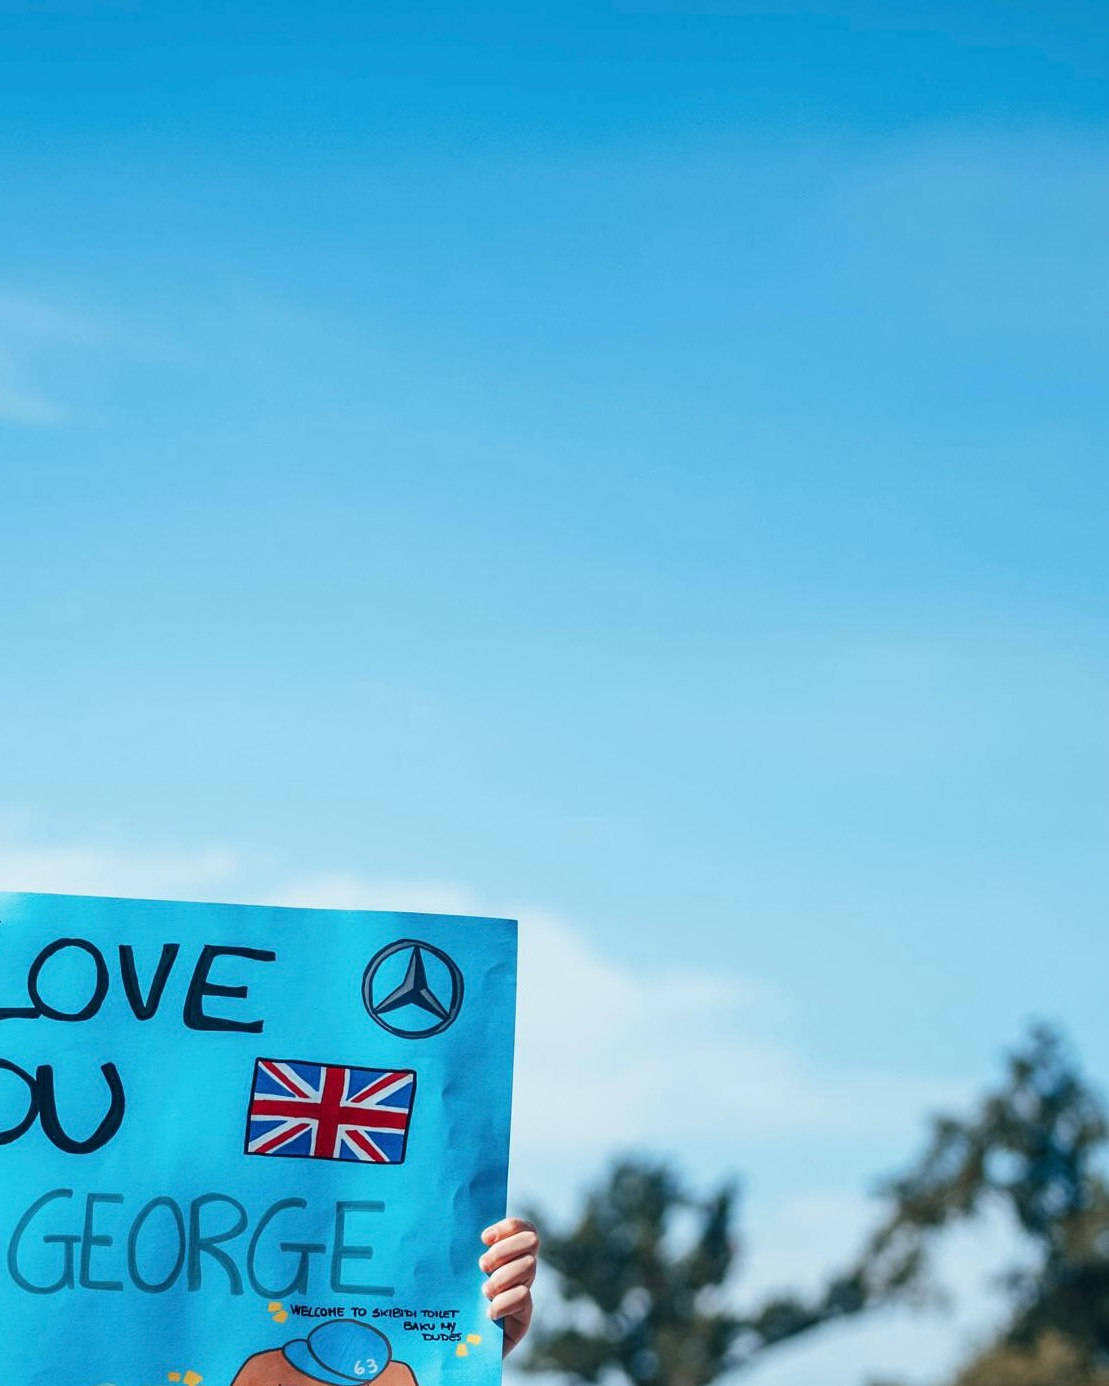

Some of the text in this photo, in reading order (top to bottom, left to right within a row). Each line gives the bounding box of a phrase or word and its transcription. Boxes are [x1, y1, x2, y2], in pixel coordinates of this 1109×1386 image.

[6, 1187, 396, 1299] GEORGE
[290, 1304, 461, 1319] WELCOME TO SKIBIDI TOILET
[403, 1321, 456, 1334] BAKU MY
[353, 1358, 379, 1375] 63
